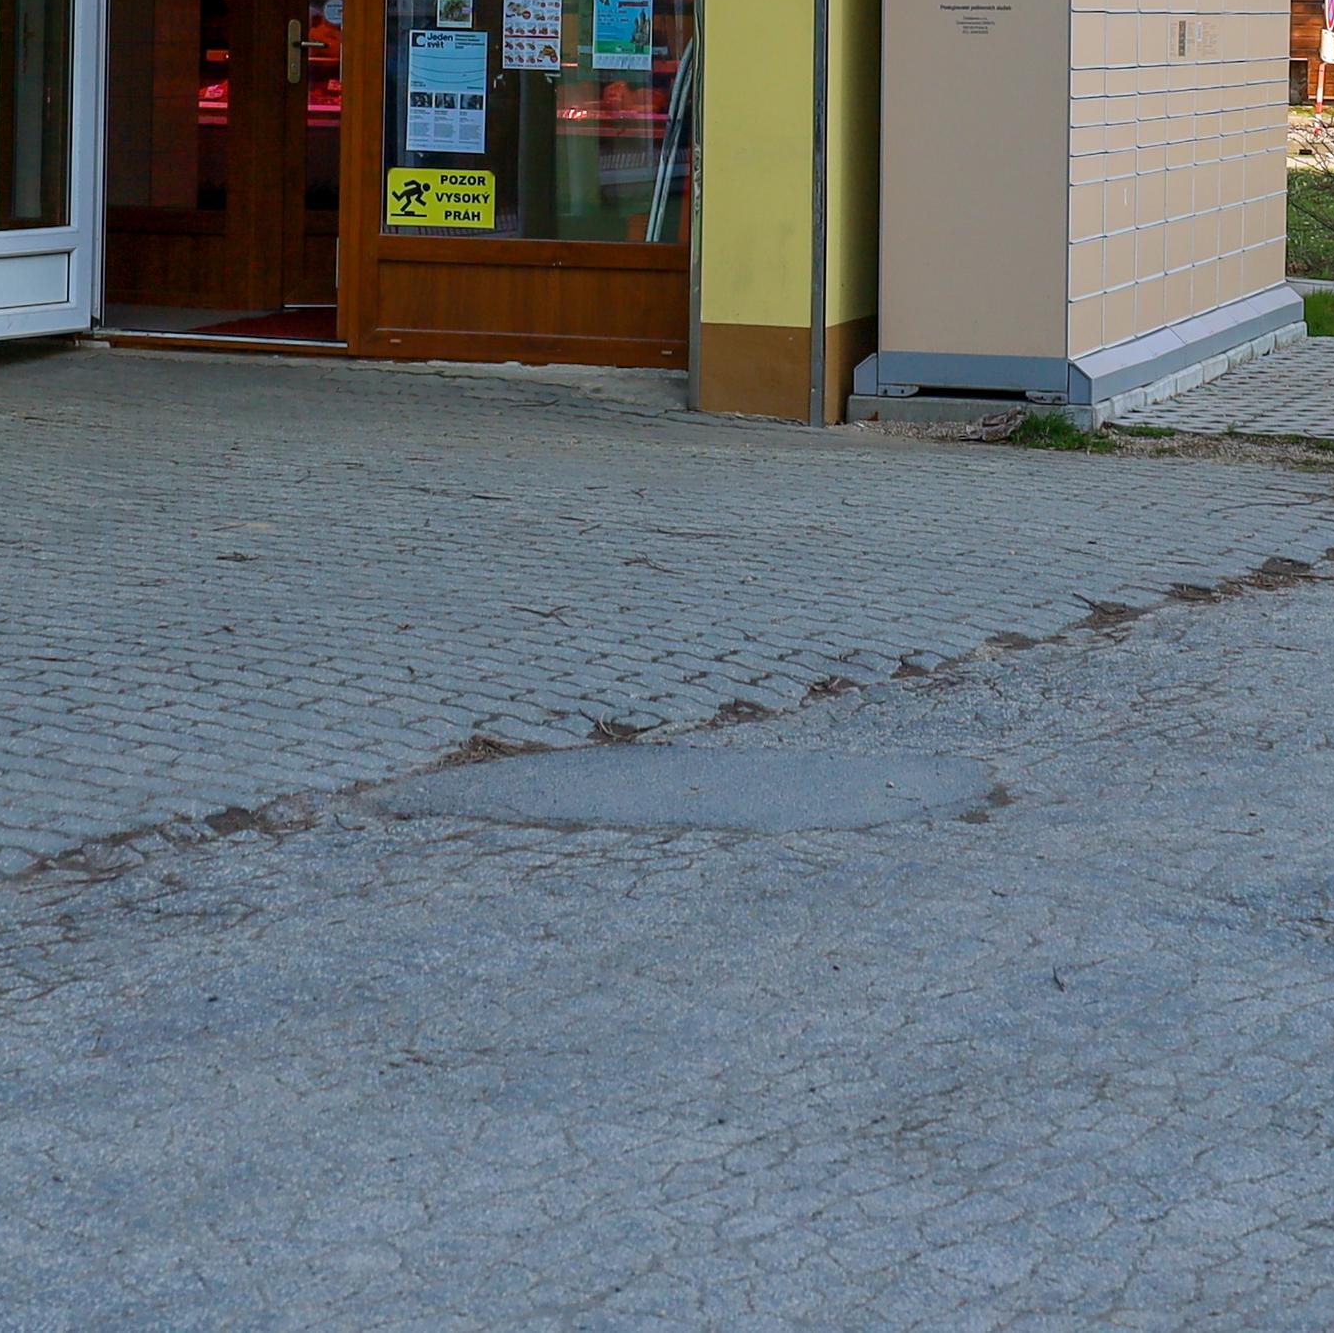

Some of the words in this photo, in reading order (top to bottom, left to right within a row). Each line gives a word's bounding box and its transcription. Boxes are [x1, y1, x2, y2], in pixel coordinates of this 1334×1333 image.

[427, 33, 453, 42] Jeden
[440, 175, 486, 186] POZOR
[435, 192, 490, 204] VYSOKÝ
[444, 209, 481, 222] PRÁH
